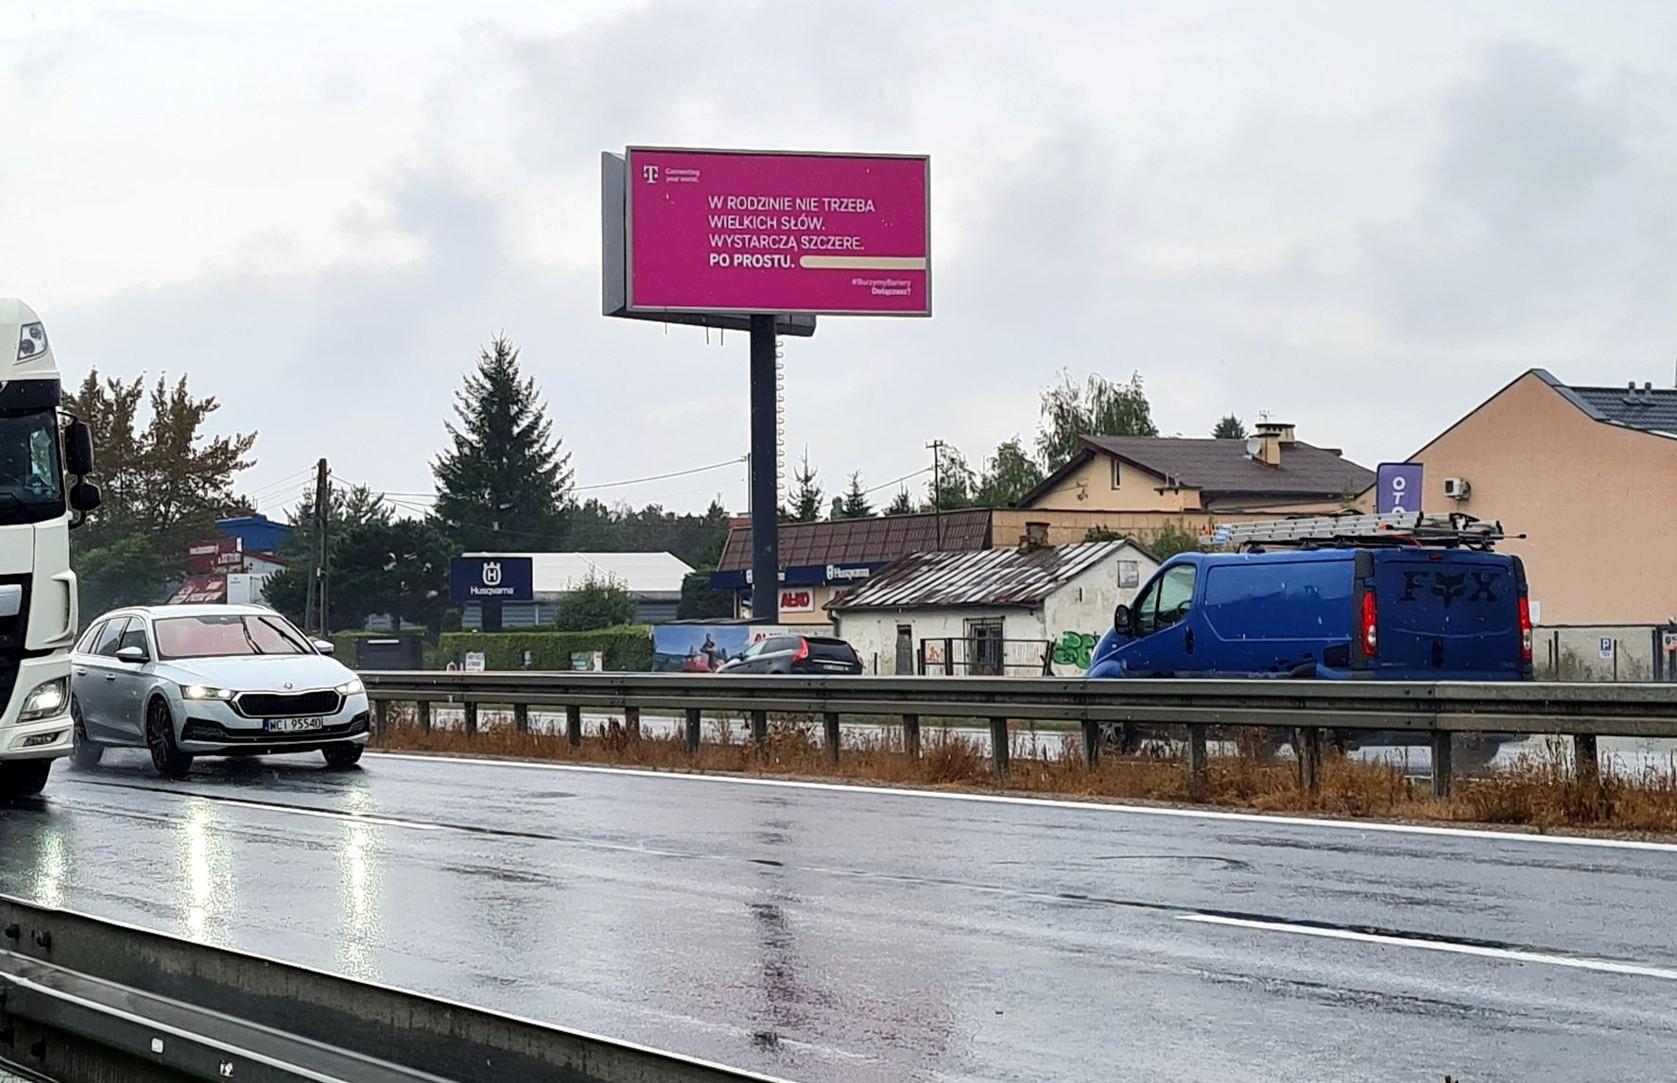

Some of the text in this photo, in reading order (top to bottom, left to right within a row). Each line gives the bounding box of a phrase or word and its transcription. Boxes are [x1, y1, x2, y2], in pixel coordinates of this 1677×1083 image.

[643, 165, 659, 184] T
[708, 195, 876, 213] W RODZINIE NIE TRZEBA
[708, 213, 826, 231] WIELKICH SŁÓW.
[708, 234, 865, 251] WYSTARCZĄ SZCZERE.
[709, 253, 796, 269] PO PROSTU.
[470, 586, 514, 596] Husqvarna
